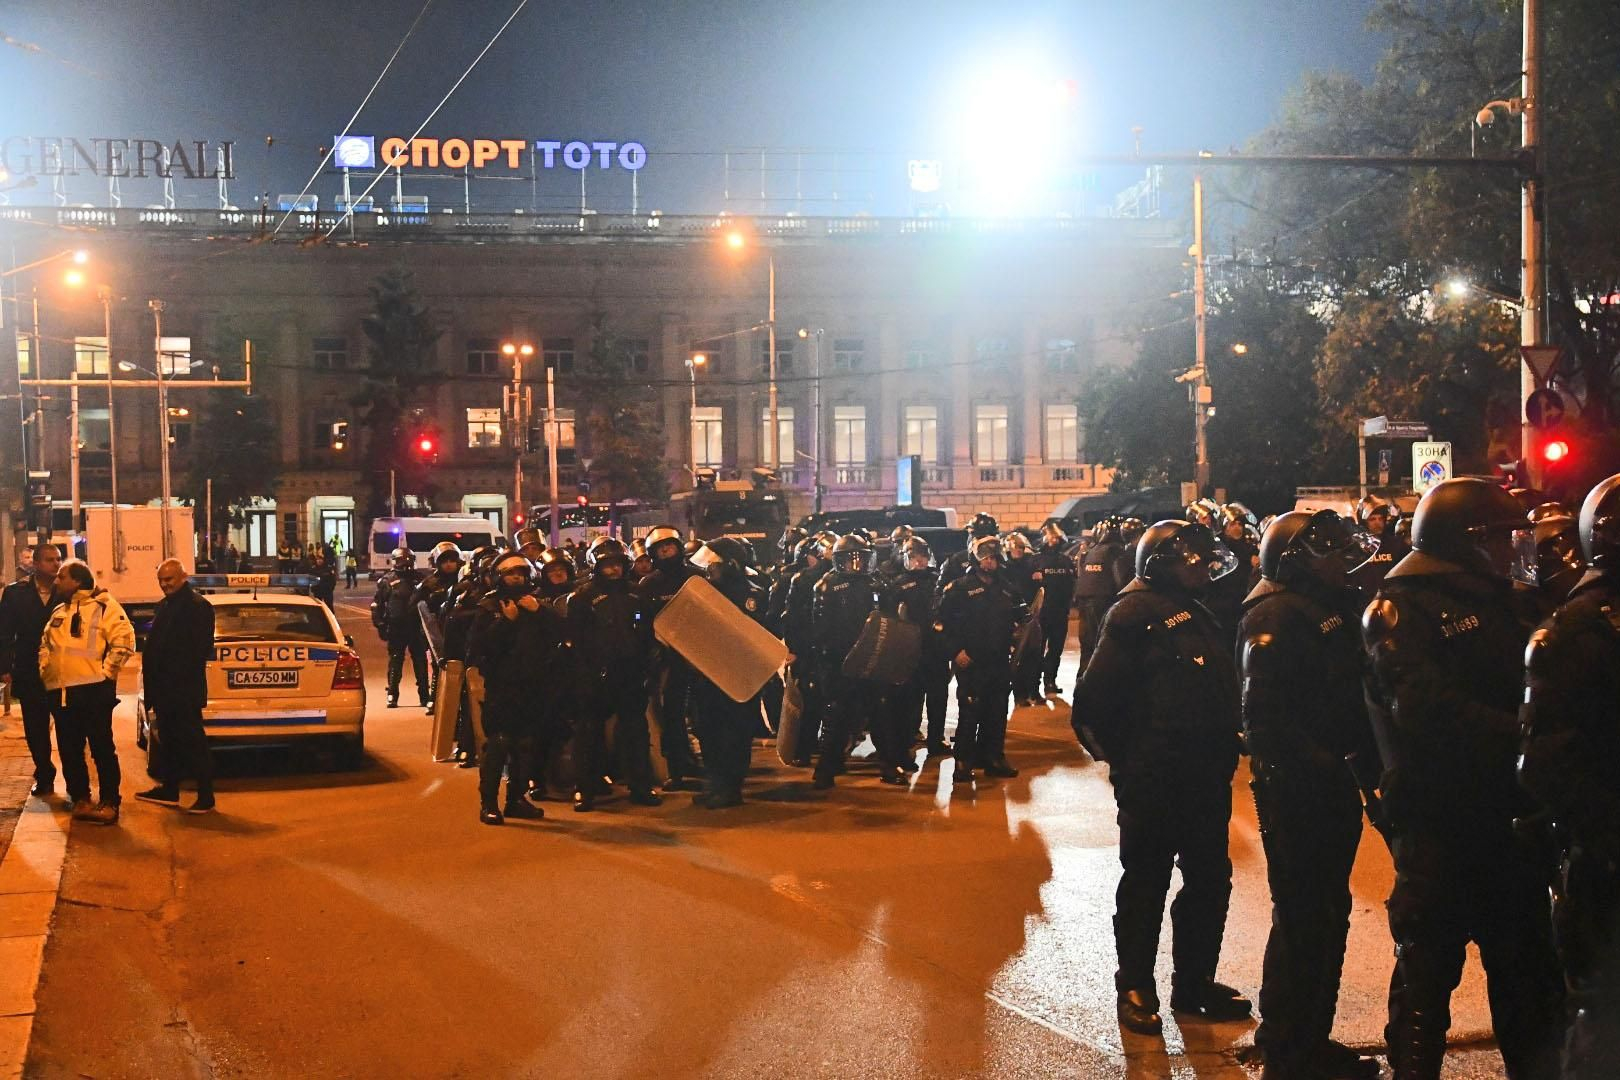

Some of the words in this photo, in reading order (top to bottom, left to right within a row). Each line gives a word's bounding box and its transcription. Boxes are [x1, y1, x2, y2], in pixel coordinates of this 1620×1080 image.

[3, 135, 236, 180] GENERALI
[381, 137, 526, 168] СПОРТ
[536, 141, 647, 169] ТОТО
[1417, 447, 1447, 457] ЗОНА
[230, 576, 266, 584] POLICE
[220, 646, 305, 662] POLICE
[252, 672, 280, 683] 6750
